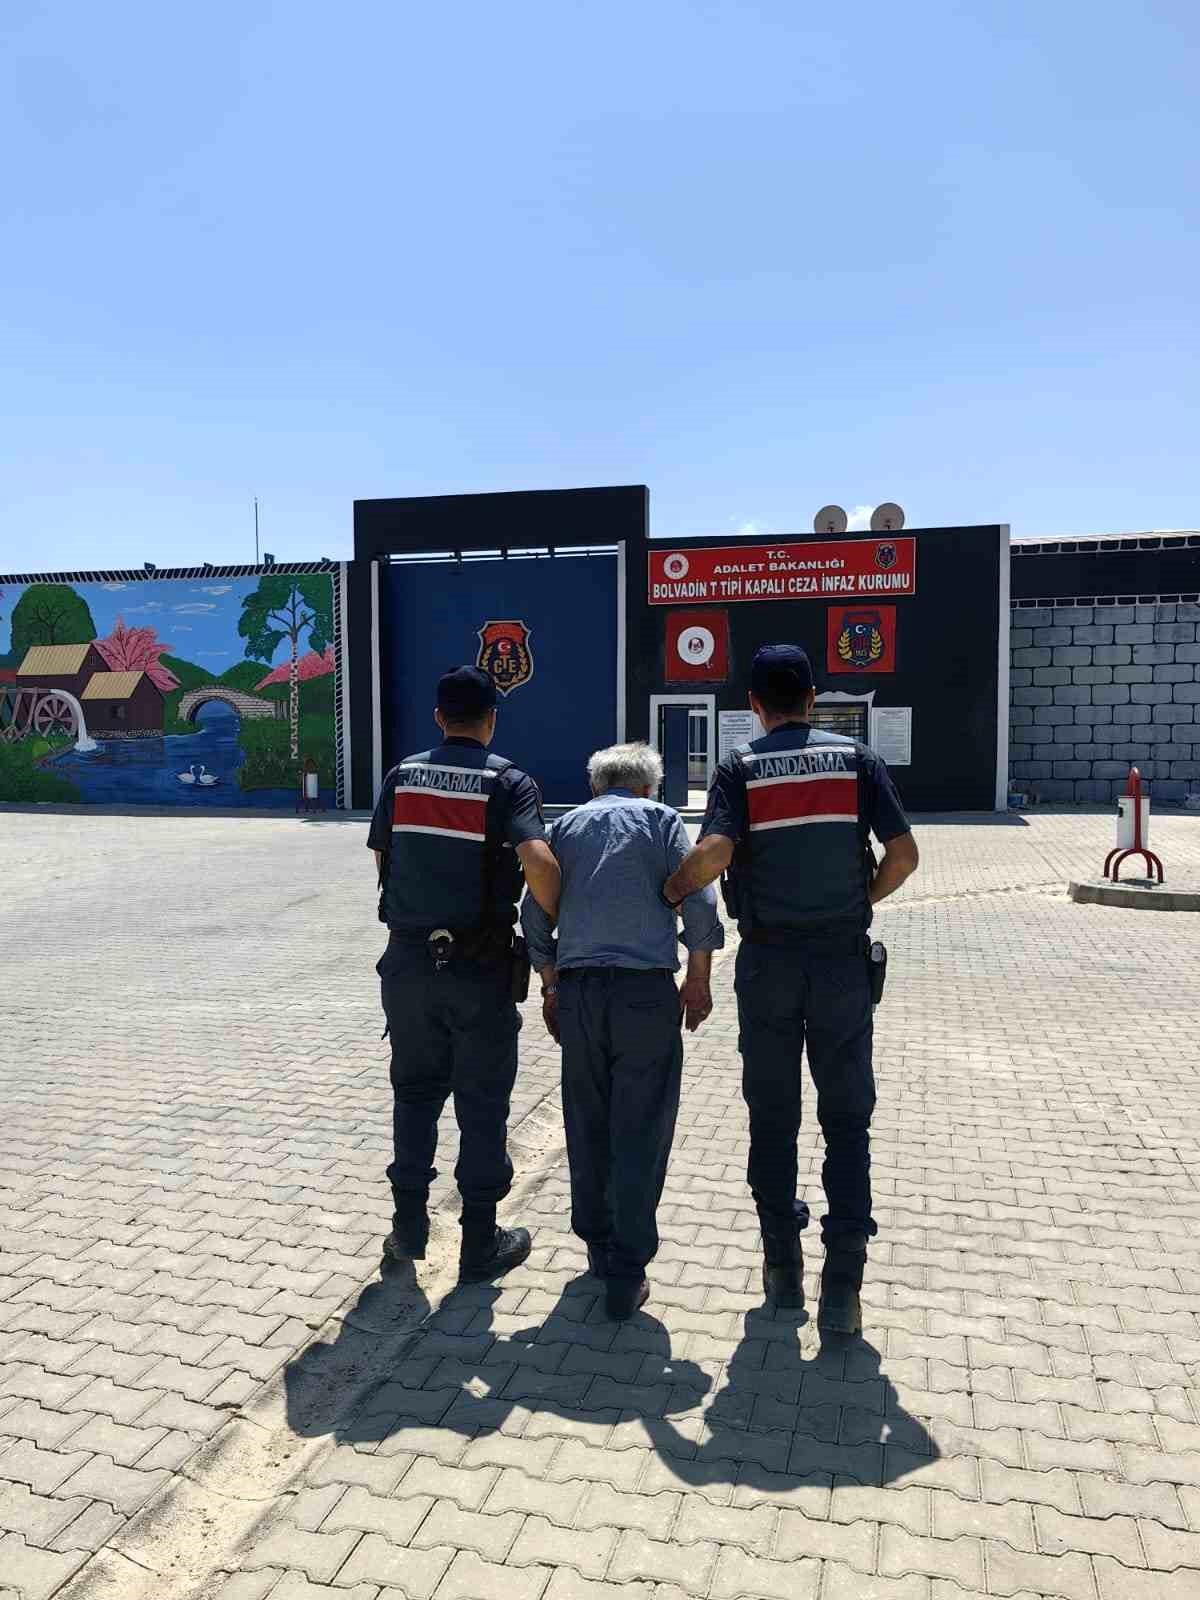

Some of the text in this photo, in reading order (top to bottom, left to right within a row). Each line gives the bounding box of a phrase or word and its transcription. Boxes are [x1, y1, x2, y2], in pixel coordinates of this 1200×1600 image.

[713, 558, 845, 574] ADALET BAKANLIĞI
[766, 550, 791, 560] T.C.
[653, 573, 910, 598] BOLVADİN T TİPİ KAPALI CEZA İNFAZ KURUMU
[754, 752, 848, 778] JANDARMA
[403, 768, 483, 793] JANDARMA
